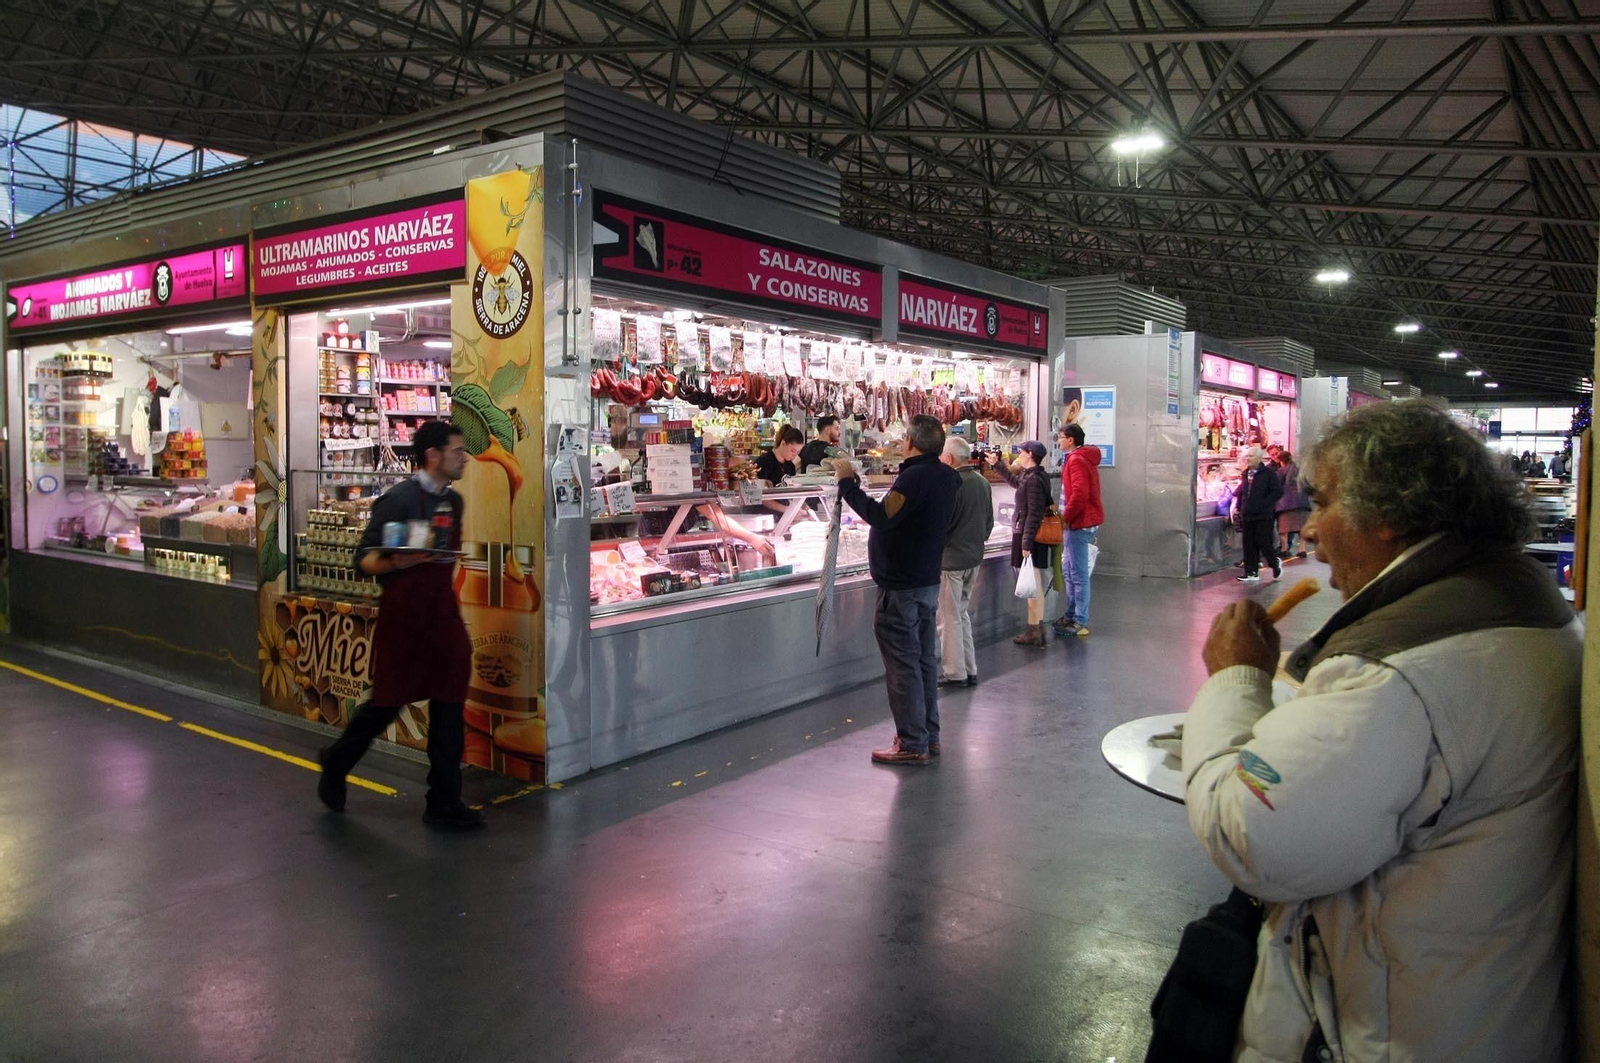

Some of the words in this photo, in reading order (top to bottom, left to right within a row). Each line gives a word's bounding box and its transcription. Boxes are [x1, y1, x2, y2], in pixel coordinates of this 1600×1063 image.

[260, 228, 370, 265] ULTRAMARINOS
[374, 210, 454, 245] NARVÁEZ
[260, 262, 307, 278] MOJAMAS
[315, 250, 376, 269] AHUMADOS
[385, 238, 454, 258] CONSERVAS
[511, 254, 526, 277] MIEL
[759, 248, 861, 287] SALAZONES
[65, 273, 121, 299] AHUMADOS
[121, 270, 133, 290] Y
[175, 266, 212, 280] Ayuntamiento
[184, 281, 192, 290] de
[193, 278, 213, 289] Huelva
[296, 268, 355, 285] LEGUMBRES
[364, 261, 408, 276] ACEITES
[50, 297, 98, 320] MOJAMAS
[100, 287, 151, 313] NARVÁEZ
[748, 272, 761, 290] Y
[766, 277, 869, 313] CONSERVAS
[475, 298, 492, 332] SIERRA
[493, 324, 504, 335] DE
[504, 291, 530, 334] ARACENA
[901, 293, 978, 333] NARVÁEZ
[489, 634, 498, 644] DE
[499, 633, 530, 652] ARACENA
[332, 676, 352, 688] SIERRA
[352, 681, 362, 690] DE
[332, 684, 361, 698] ARACENA
